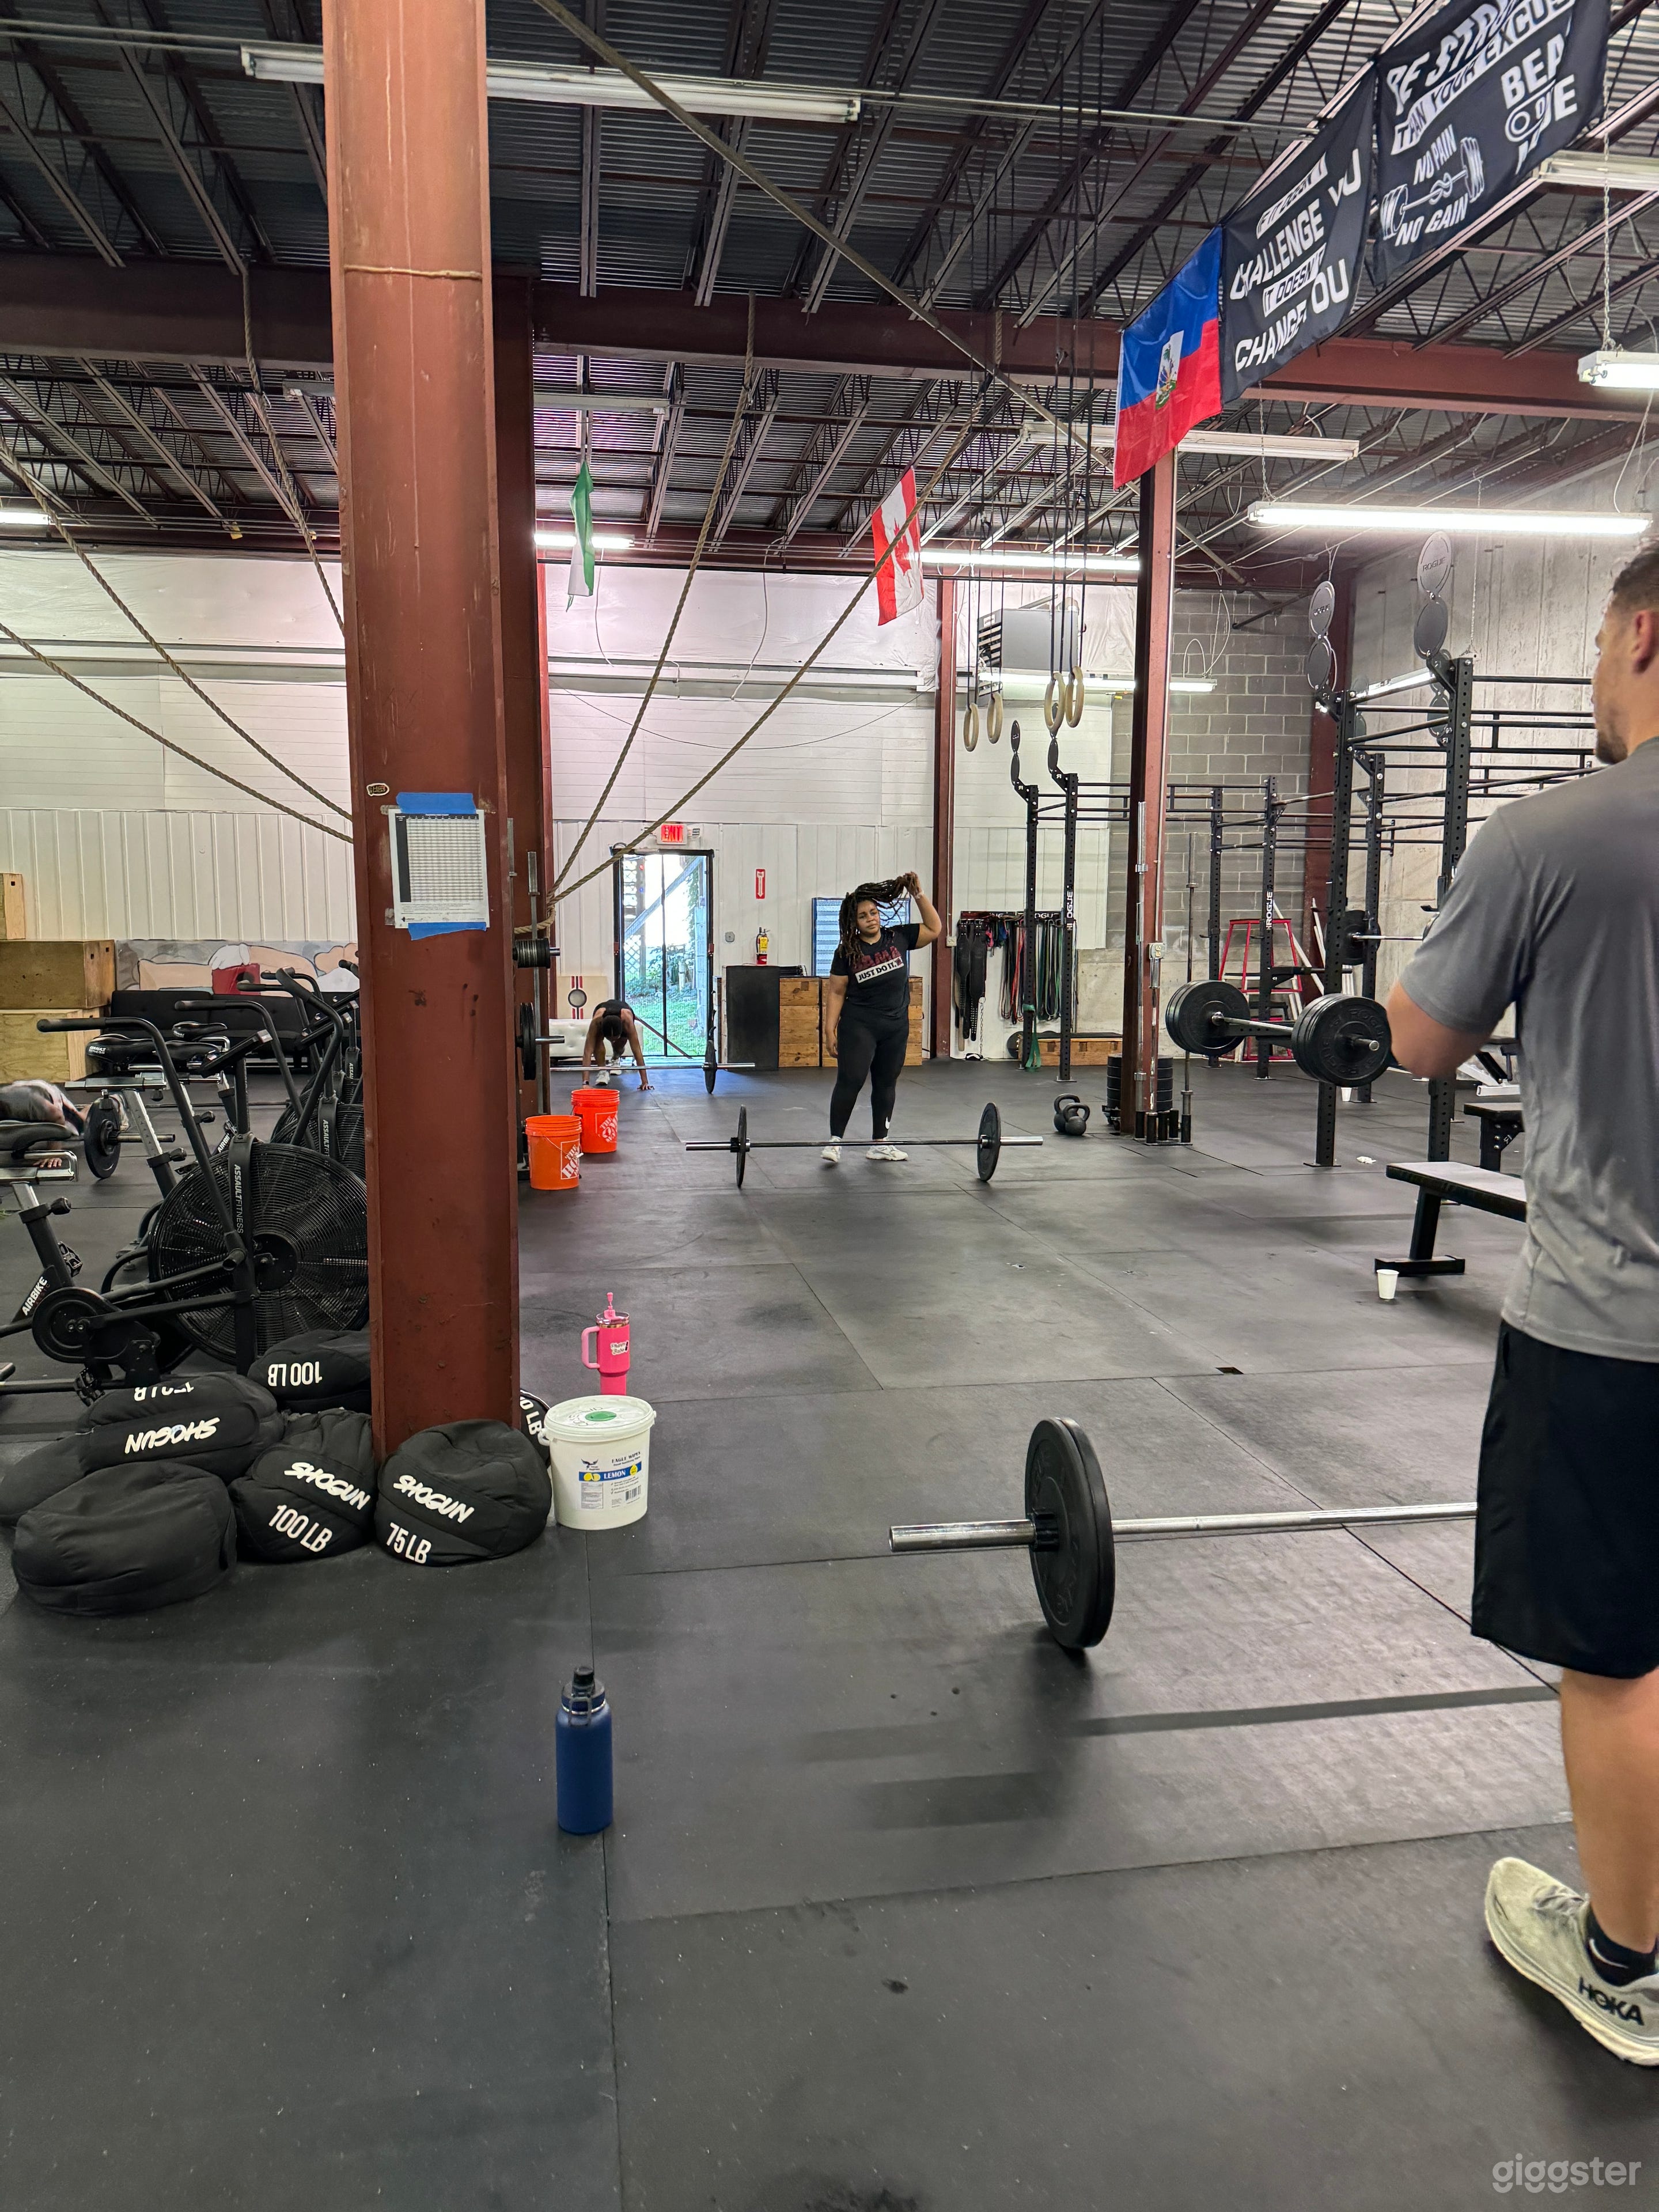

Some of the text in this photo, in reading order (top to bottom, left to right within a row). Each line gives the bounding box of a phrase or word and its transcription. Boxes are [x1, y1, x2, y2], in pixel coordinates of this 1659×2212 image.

[1413, 124, 1457, 185] NO PAIN
[1395, 193, 1468, 247] NO GAIN
[1230, 198, 1324, 300] CHALLENGE
[1311, 259, 1349, 314] OU
[660, 825, 684, 842] EXIT
[858, 969, 874, 981] JUST
[876, 965, 888, 974] DO
[22, 1276, 48, 1316] AIRBIKE
[268, 1362, 323, 1387] 100 LB
[125, 1417, 220, 1454] SHOGUN
[526, 1411, 543, 1435] LB
[284, 1462, 370, 1510] SHOGUN
[603, 1469, 626, 1479] LEMON
[393, 1475, 475, 1523] SHOGUN
[268, 1505, 333, 1553] 100 LB
[386, 1522, 432, 1564] 75 LB
[1578, 1977, 1645, 2027] HOKA
